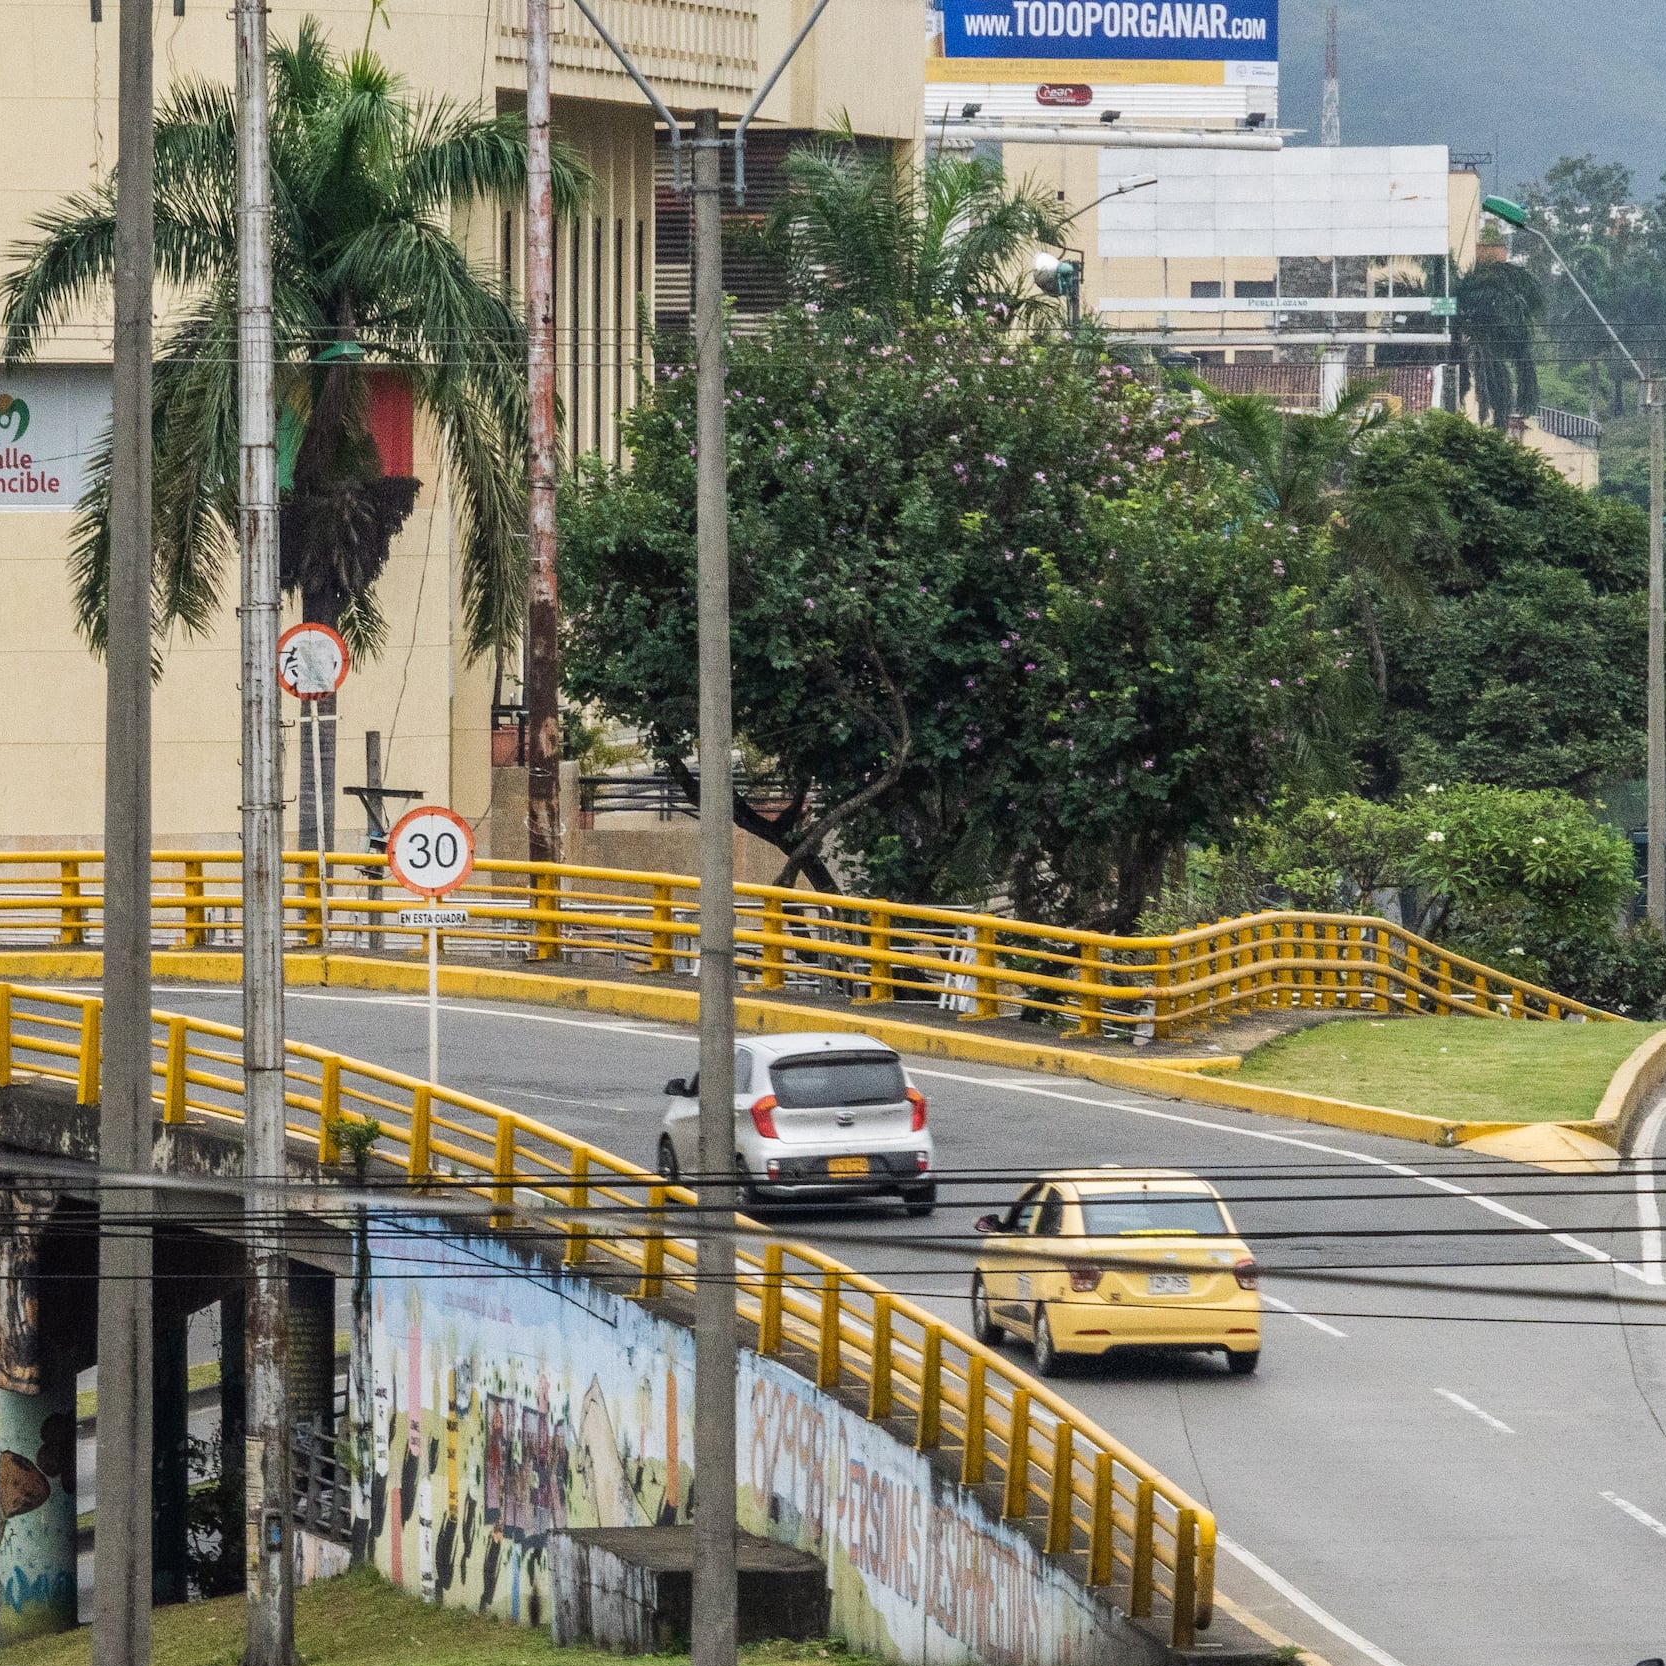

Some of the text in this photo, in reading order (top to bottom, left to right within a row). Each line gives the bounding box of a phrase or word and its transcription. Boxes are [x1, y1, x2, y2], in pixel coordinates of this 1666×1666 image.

[408, 832, 458, 869] 30
[400, 913, 467, 924] EN ESTA CUADRA
